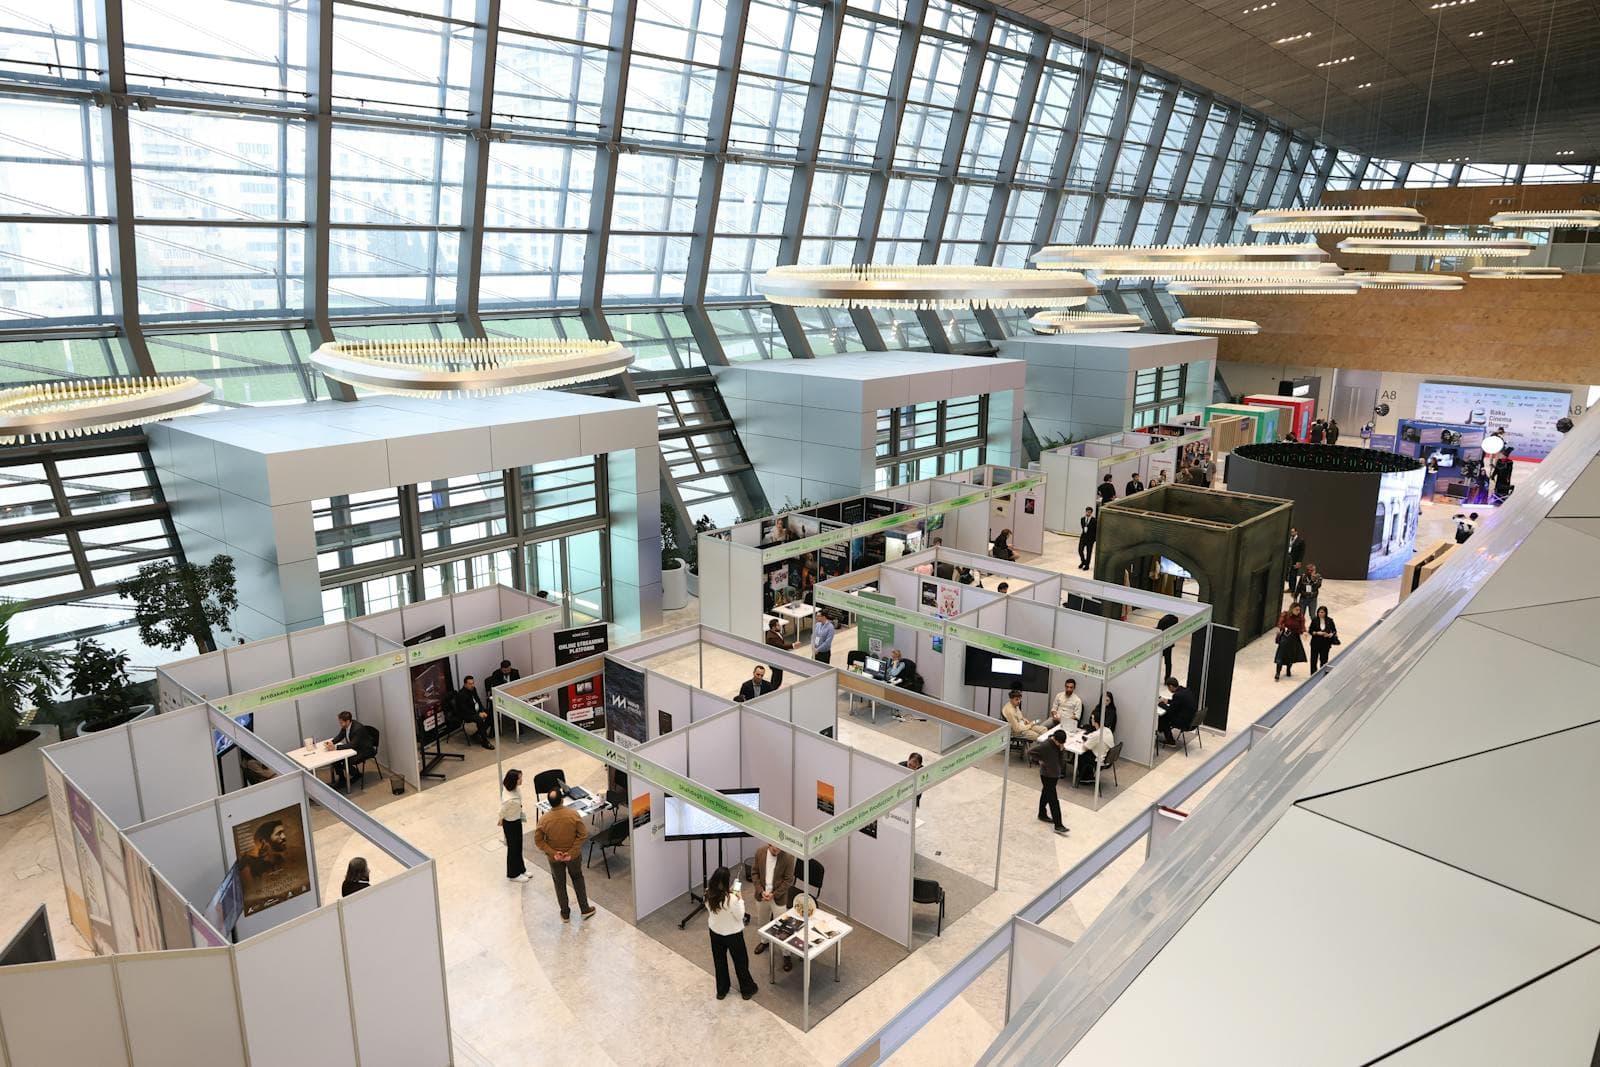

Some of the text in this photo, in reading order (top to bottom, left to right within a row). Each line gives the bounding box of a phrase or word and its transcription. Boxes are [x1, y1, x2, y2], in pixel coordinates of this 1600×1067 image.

[1381, 390, 1397, 400] A8
[1490, 408, 1506, 416] Baku
[577, 637, 605, 647] STREAMING
[569, 644, 595, 654] PLATFORM
[260, 667, 366, 701] ArtBakers Creative Advertising Agency
[869, 795, 894, 812] Production
[715, 800, 743, 819] Production
